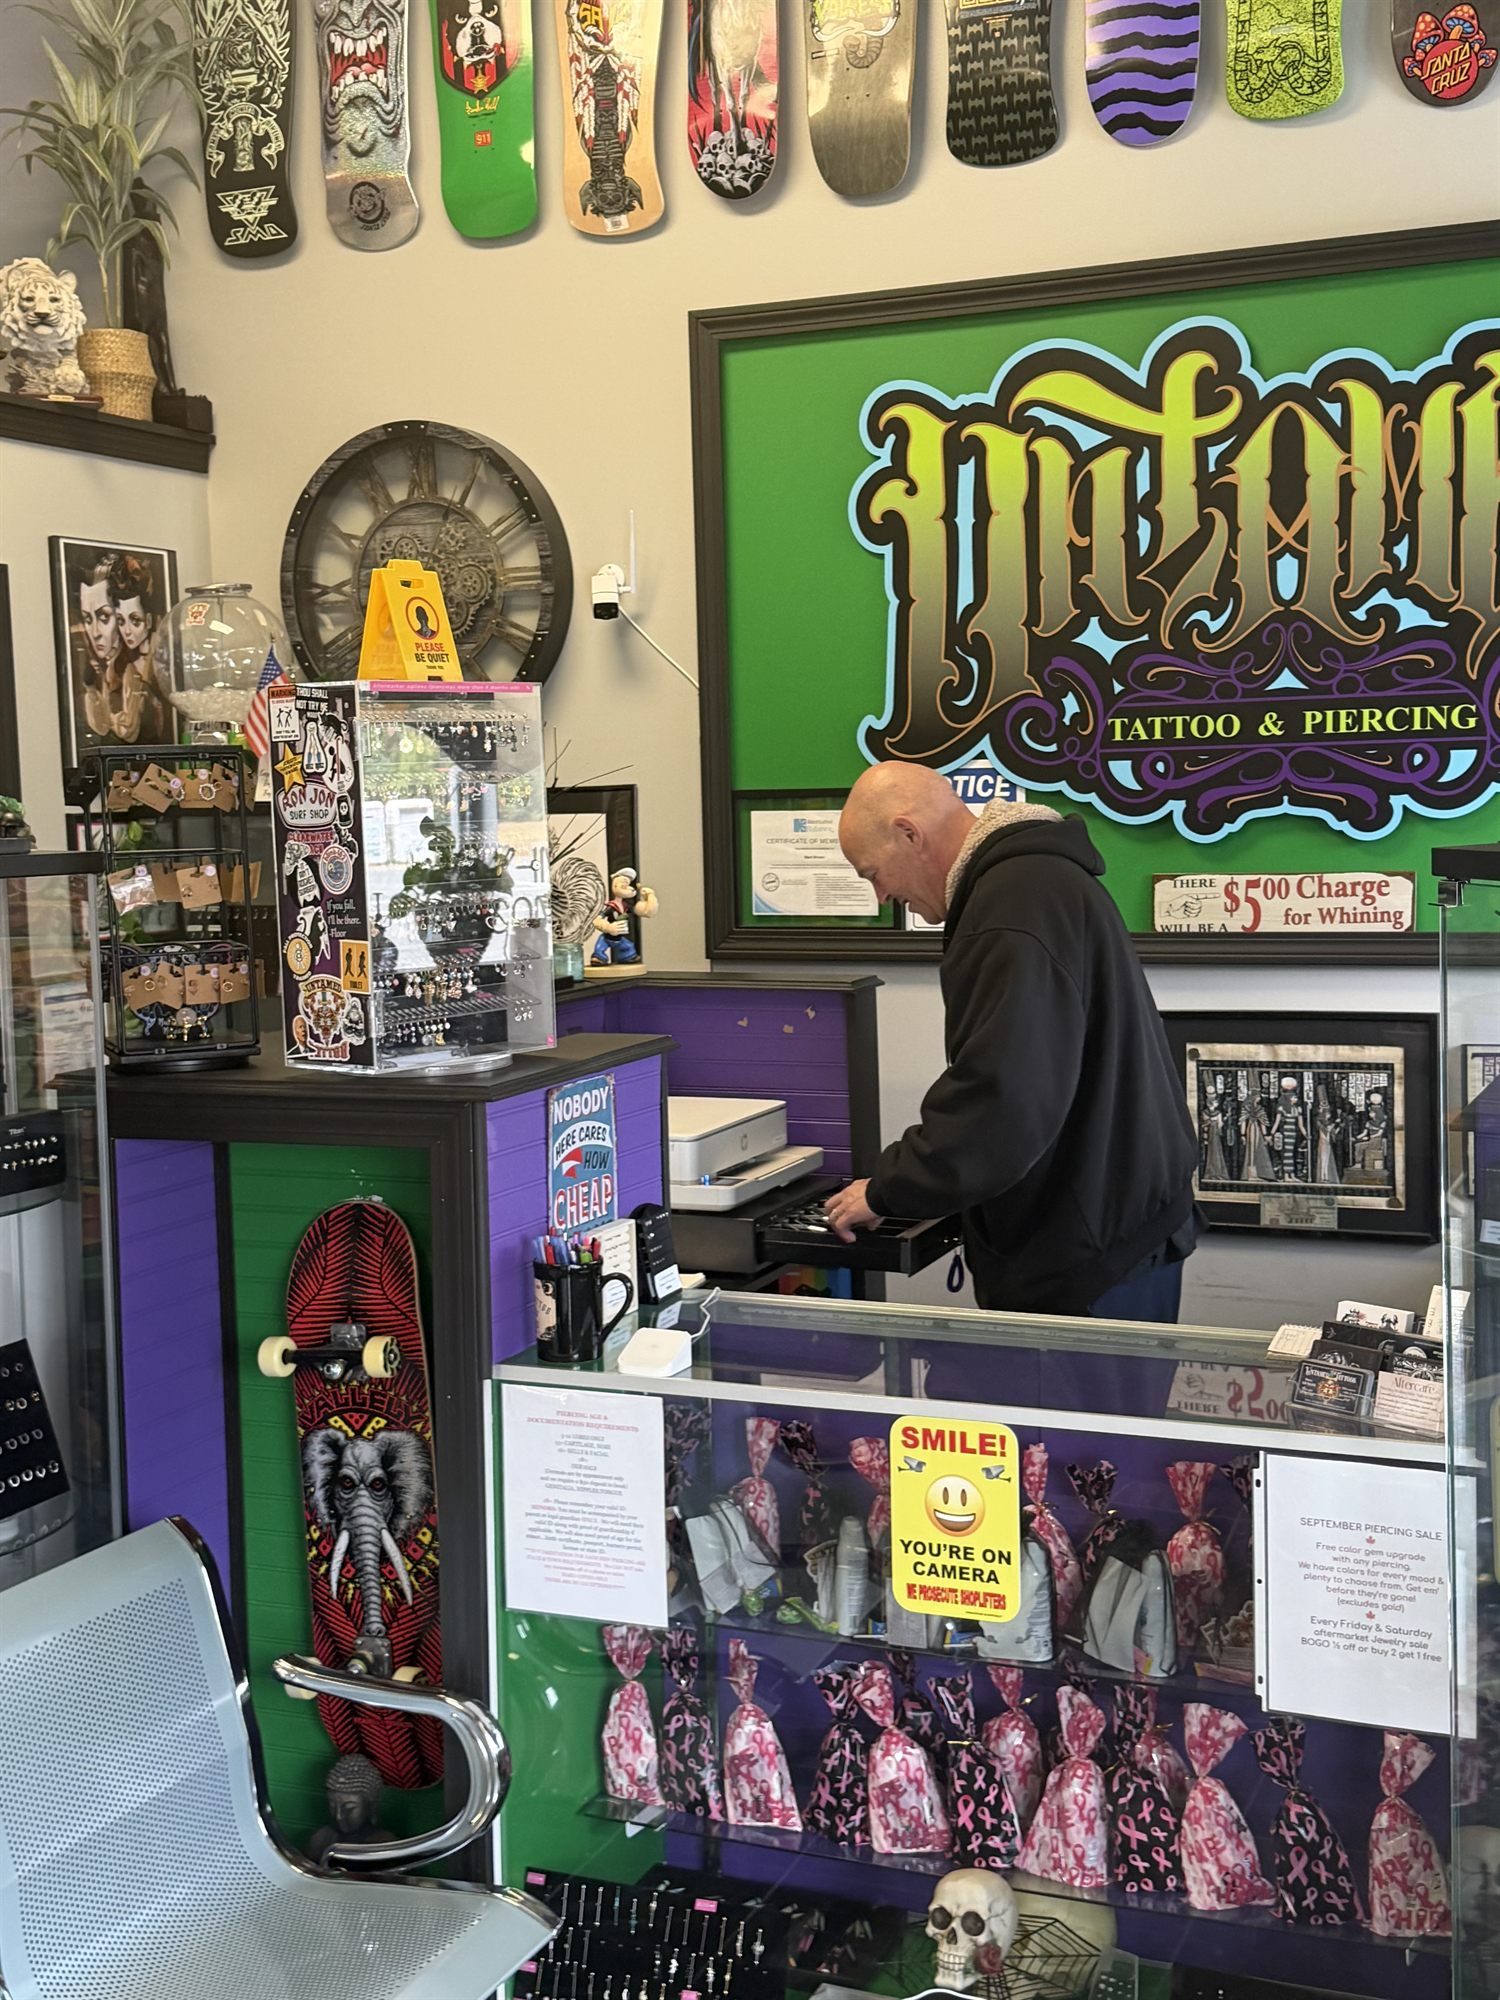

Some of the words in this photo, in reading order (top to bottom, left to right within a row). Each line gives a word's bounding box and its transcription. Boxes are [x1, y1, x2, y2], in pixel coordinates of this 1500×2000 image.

[1421, 42, 1471, 80] SANTA
[1431, 64, 1471, 96] CRUZ
[414, 653, 426, 663] BE
[427, 653, 450, 663] QUIET
[415, 642, 445, 652] PLEASE
[271, 689, 296, 697] WARNING
[296, 687, 311, 697] THOU
[311, 688, 329, 699] SHALL
[296, 700, 307, 709] NOT
[307, 701, 320, 710] TRY
[1107, 713, 1242, 742] TATTOO
[1258, 711, 1286, 737] &
[1302, 703, 1480, 735] PIERCING
[949, 774, 1012, 798] TICE
[283, 786, 308, 812] RON
[310, 788, 337, 809] JON
[289, 810, 307, 820] SURF
[309, 809, 329, 819] SHOP
[1172, 878, 1217, 889] THERE
[1296, 874, 1391, 907] Charge
[332, 903, 344, 913] you
[336, 914, 344, 925] be
[1283, 907, 1312, 925] for
[1318, 905, 1404, 930] Whining
[305, 979, 342, 993] UNTAMED
[553, 1086, 610, 1125] NOBODY
[555, 1128, 577, 1162] HERE
[578, 1125, 607, 1143] CARES
[584, 1151, 610, 1170] HOW
[553, 1174, 613, 1231] CHEAP
[298, 1386, 430, 1429] VALLELY
[901, 1426, 1007, 1458] SMILE!
[1300, 1517, 1362, 1531] SEPTEMBER
[1364, 1523, 1413, 1538] PIERCING
[1415, 1529, 1443, 1541] SALE
[900, 1539, 975, 1562] YOU'RE
[982, 1548, 1012, 1566] ON
[1316, 1542, 1337, 1551] Free
[1338, 1545, 1362, 1554] color
[1364, 1548, 1384, 1557] gem
[1386, 1551, 1426, 1562] upgrade
[1332, 1555, 1351, 1563] with
[1353, 1558, 1370, 1567] any
[913, 1561, 1000, 1585] CAMERA
[1298, 1561, 1311, 1569] We
[1313, 1563, 1335, 1571] have
[1336, 1566, 1365, 1575] colors
[1367, 1569, 1380, 1577] for
[1382, 1571, 1407, 1581] every
[1409, 1575, 1436, 1584] mood
[1437, 1577, 1445, 1585] &
[1303, 1572, 1331, 1583] plenty
[1333, 1576, 1343, 1584] to
[1345, 1578, 1378, 1588] choose
[1406, 1583, 1422, 1592] Get
[906, 1582, 918, 1600] WE
[919, 1583, 958, 1605] PROSECUTE
[960, 1589, 1007, 1611] SHOPLIFTERS
[1326, 1585, 1355, 1595] before
[1358, 1589, 1388, 1599] they're
[1337, 1596, 1380, 1609] (excludes
[1381, 1603, 1405, 1613] gold)
[1310, 1615, 1339, 1628] Every
[1340, 1619, 1373, 1632] Friday
[1375, 1623, 1383, 1632] &
[1385, 1625, 1433, 1640] Saturday
[1314, 1628, 1369, 1642] aftermarket
[1371, 1635, 1407, 1648] Jewelry
[1409, 1641, 1429, 1649] sale
[1300, 1636, 1330, 1648] BOGO
[1342, 1642, 1356, 1651] off
[1371, 1646, 1389, 1657] buy
[1391, 1648, 1397, 1657] 2
[1399, 1651, 1414, 1659] get
[1416, 1651, 1421, 1659] 1
[1422, 1652, 1442, 1662] free
